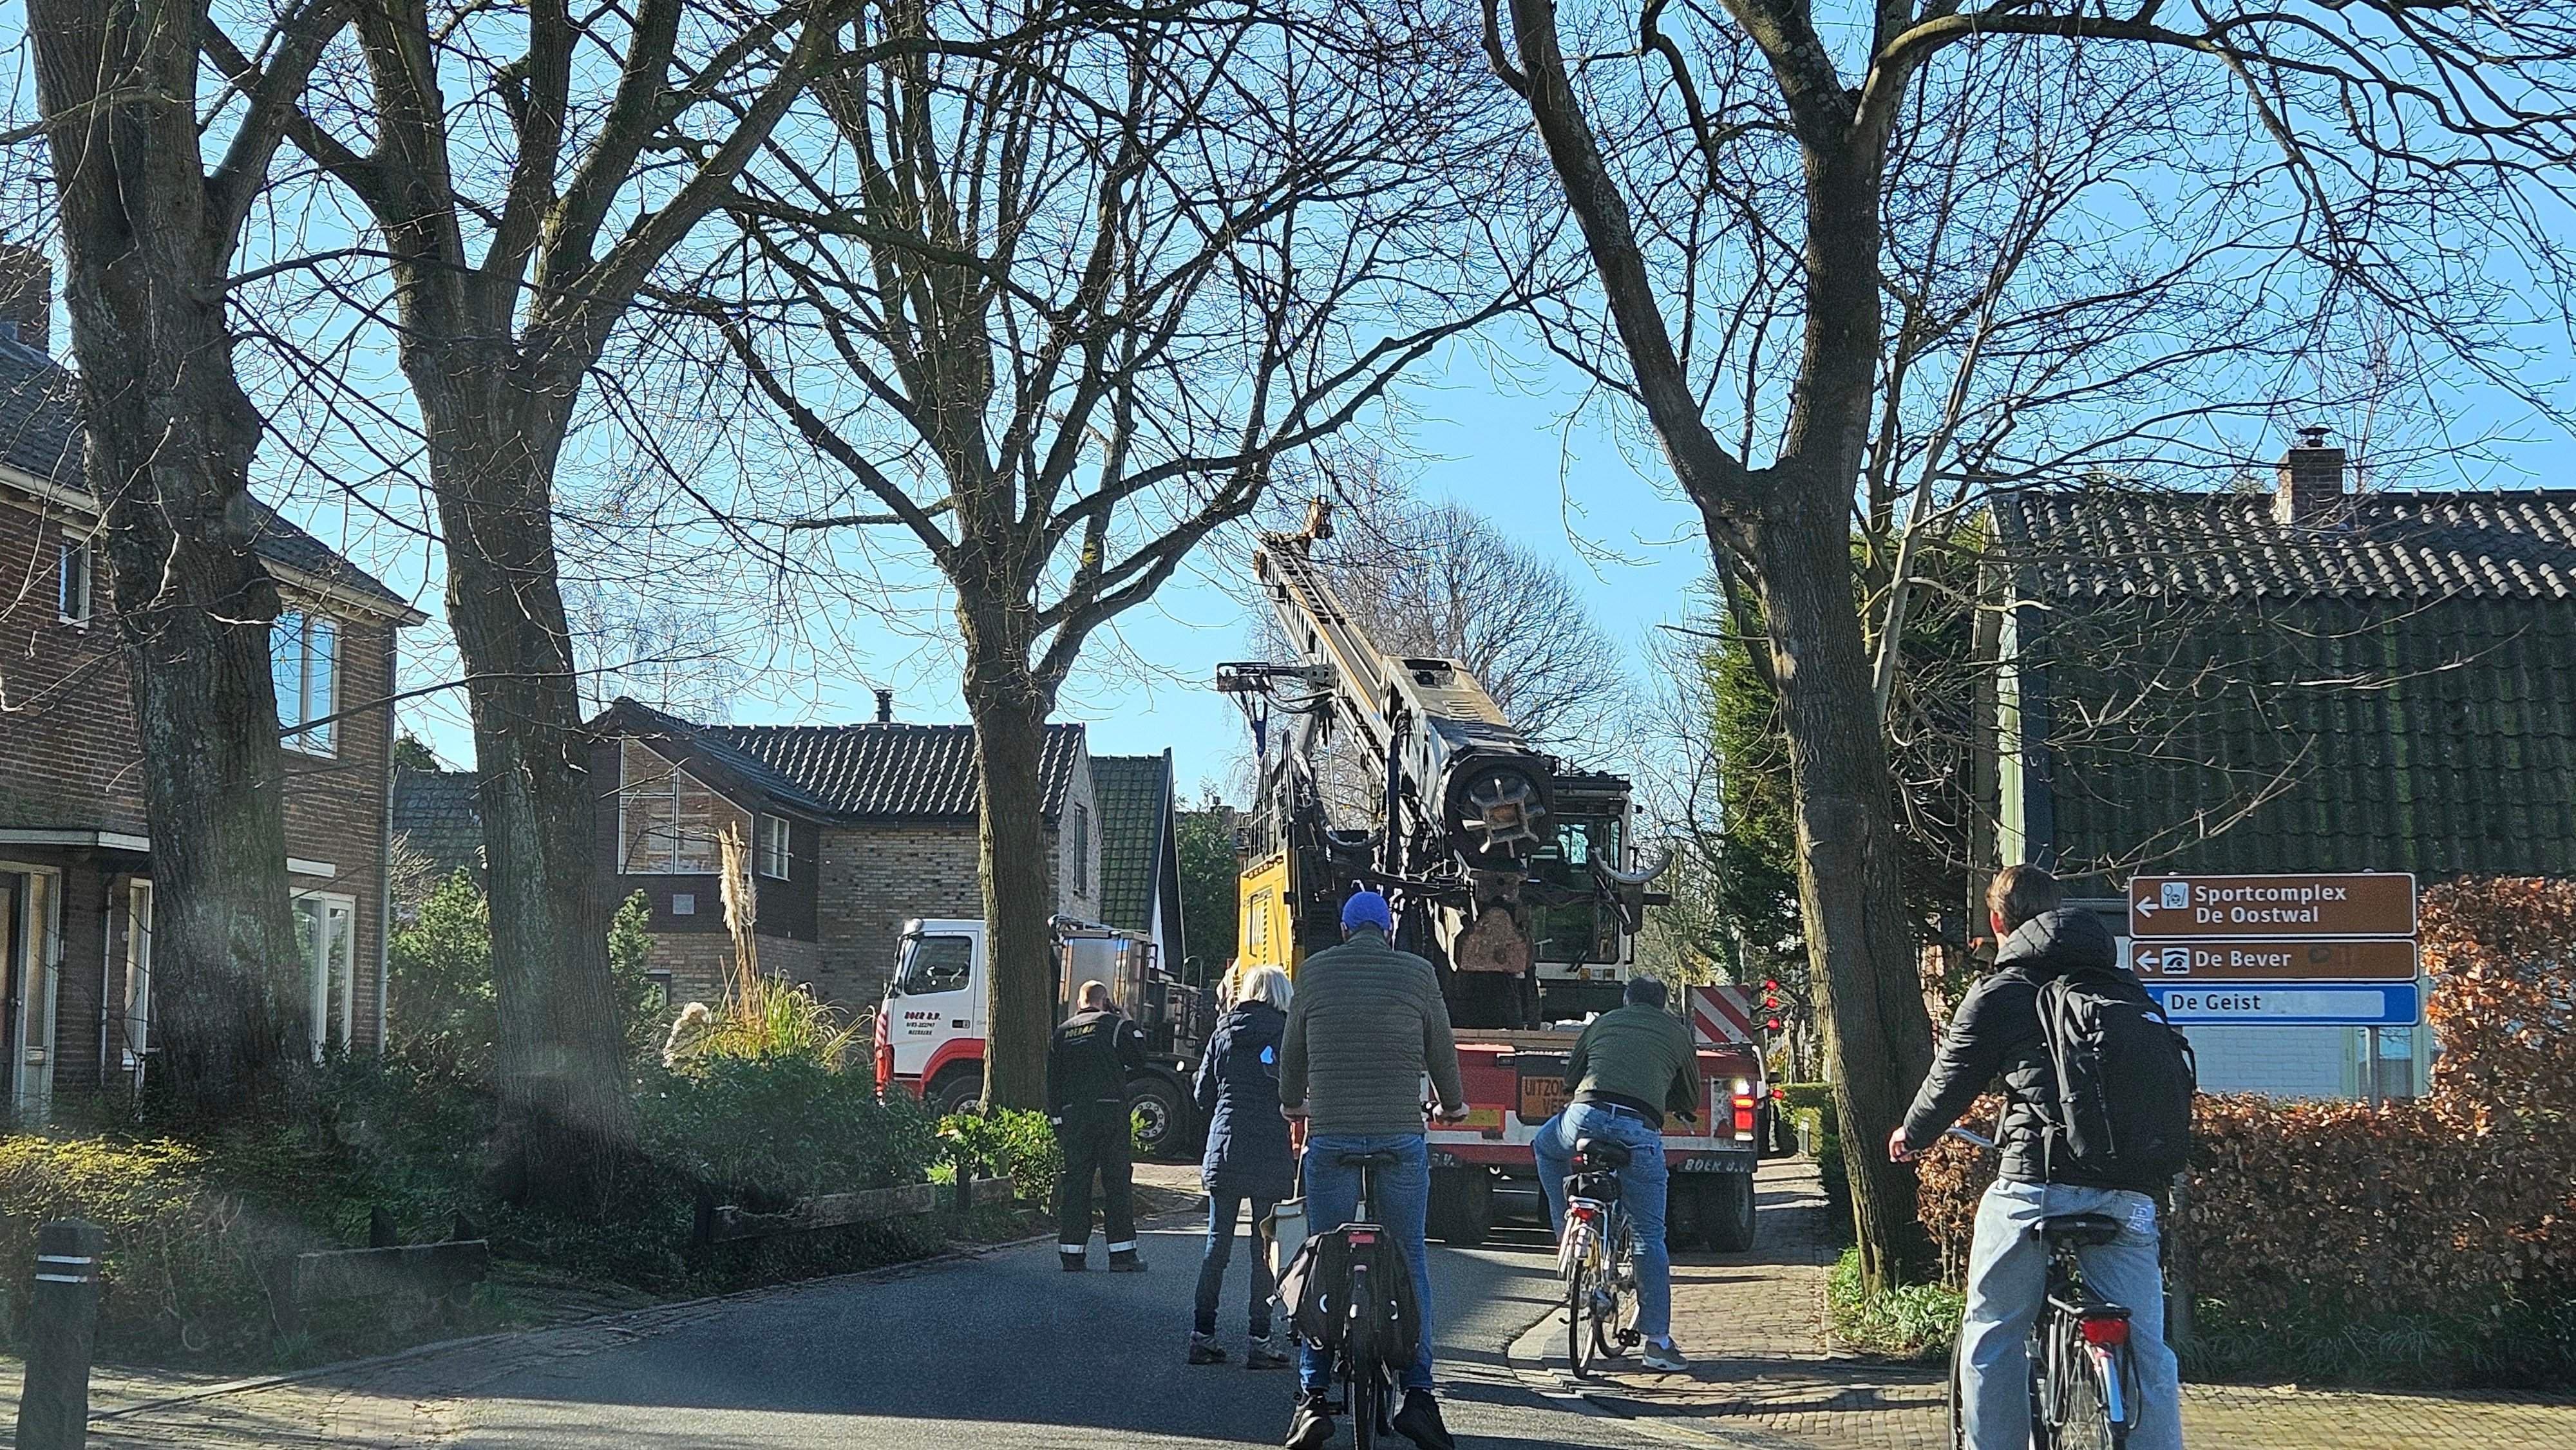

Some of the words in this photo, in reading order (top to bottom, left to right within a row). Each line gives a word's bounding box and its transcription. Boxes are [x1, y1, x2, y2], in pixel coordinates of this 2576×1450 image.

[2194, 883, 2347, 906] Sportcomplex
[2195, 907, 2224, 924] De
[2230, 905, 2319, 923] Oostwal
[2195, 950, 2222, 967] De
[2230, 950, 2292, 967] Bever
[2171, 993, 2198, 1010] De
[2205, 993, 2262, 1010] Geist
